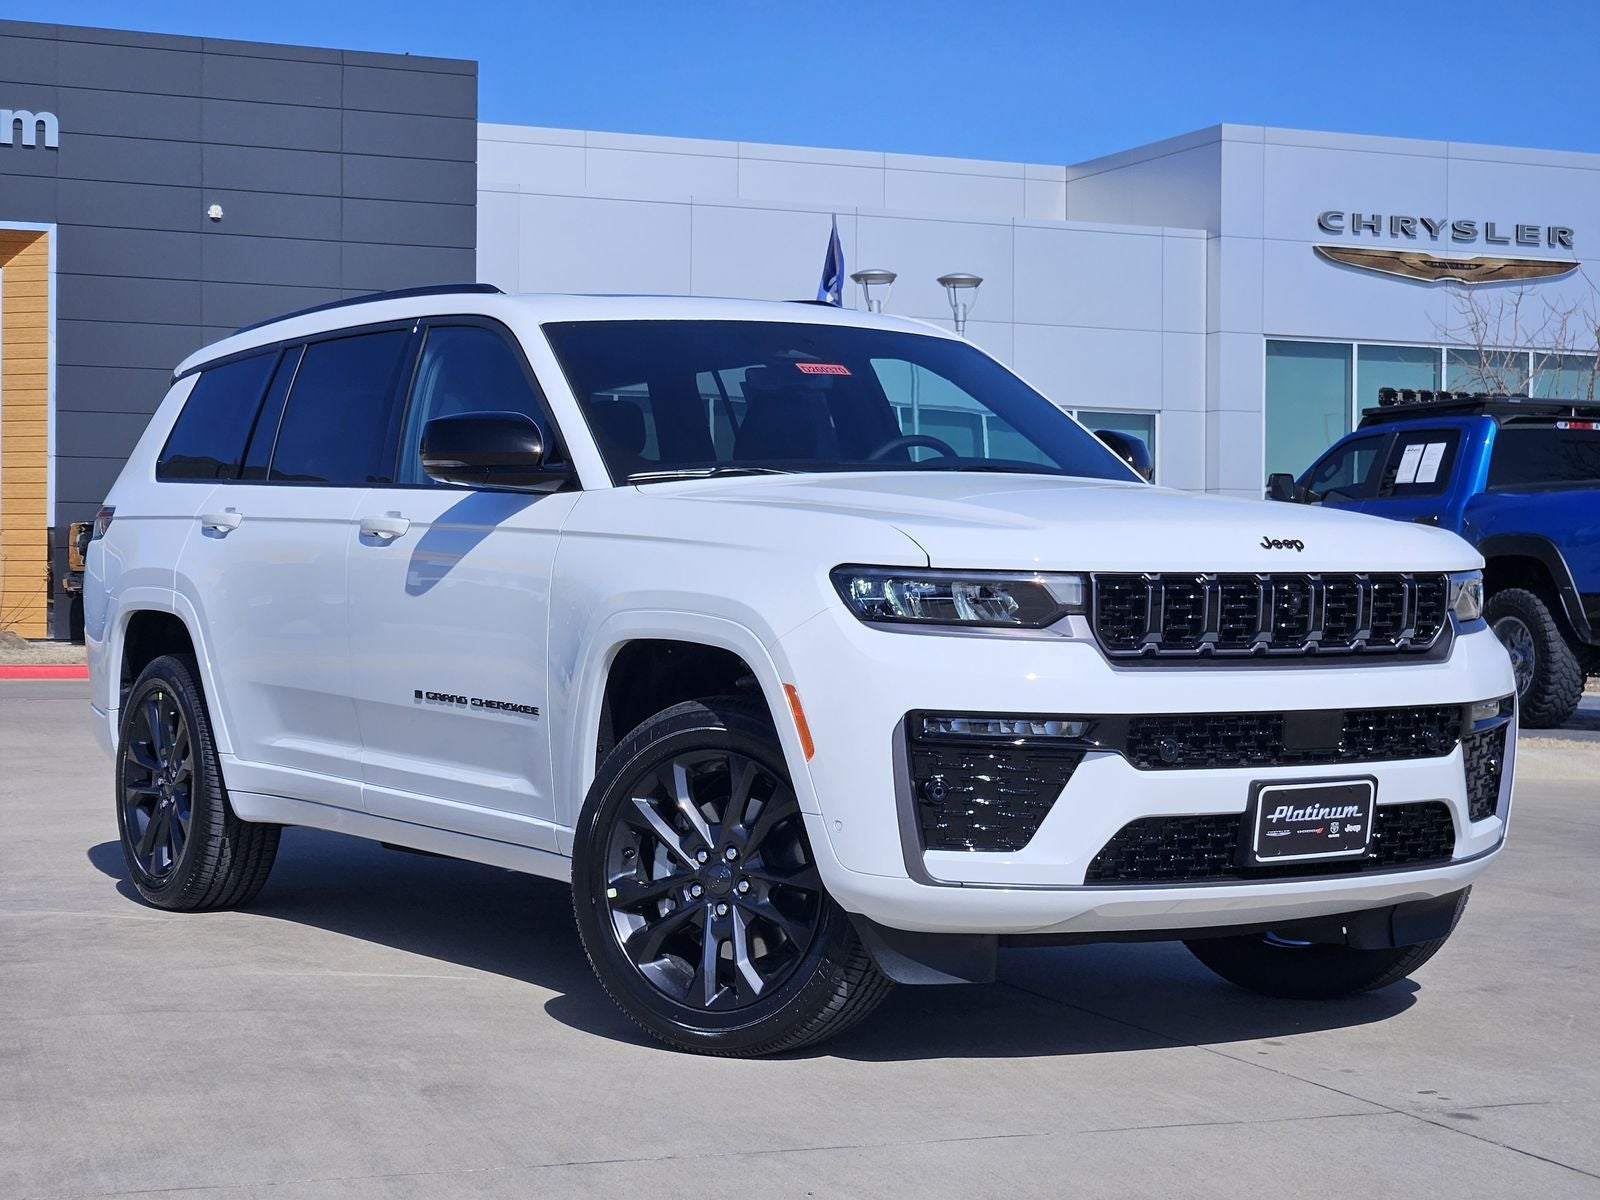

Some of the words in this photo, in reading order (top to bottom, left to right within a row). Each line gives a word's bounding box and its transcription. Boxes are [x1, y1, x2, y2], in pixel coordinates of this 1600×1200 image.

[1318, 210, 1575, 249] CHRYSLER
[1260, 536, 1305, 552] Jeep
[425, 692, 468, 704] GRAND
[470, 698, 540, 716] CHEROKEE
[1266, 803, 1363, 823] Platinum
[1345, 824, 1362, 833] Jeep
